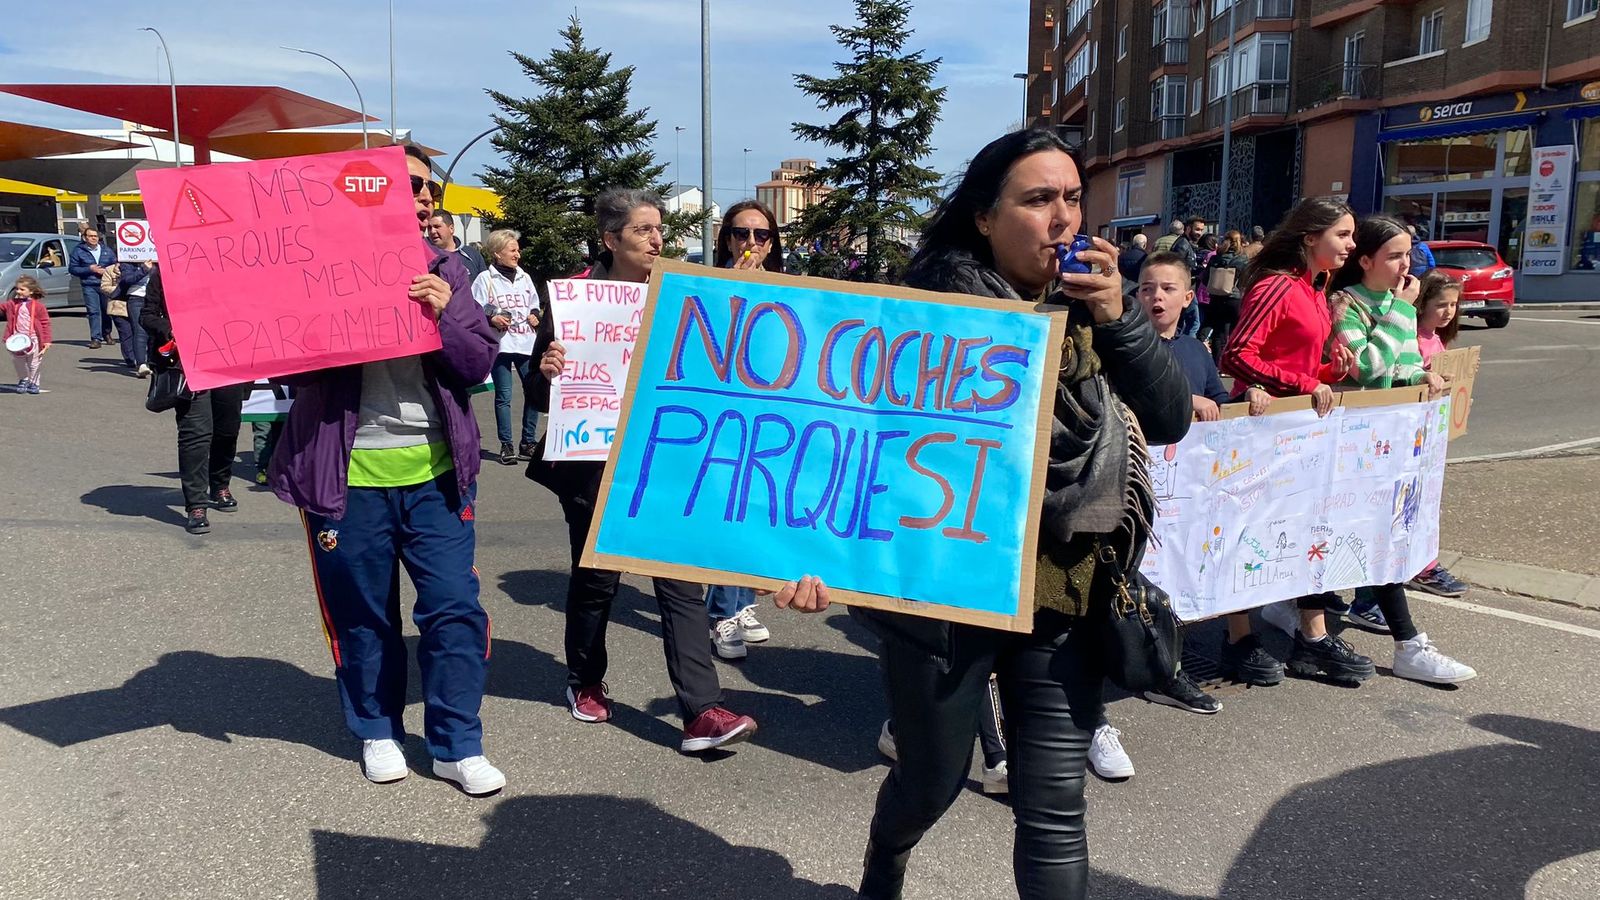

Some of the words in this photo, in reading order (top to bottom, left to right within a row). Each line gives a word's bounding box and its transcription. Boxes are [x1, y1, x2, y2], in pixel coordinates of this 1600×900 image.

[1433, 101, 1473, 118] serca
[248, 160, 334, 219] MÁS
[345, 176, 388, 193] STOP
[166, 225, 314, 275] PARQUES
[303, 246, 425, 299] MENOS
[1531, 259, 1556, 267] serca
[587, 283, 641, 306] FUTURO
[561, 320, 585, 342] EL
[665, 295, 806, 391] NO
[817, 318, 1031, 413] COCHES
[560, 360, 611, 383] ELLOS
